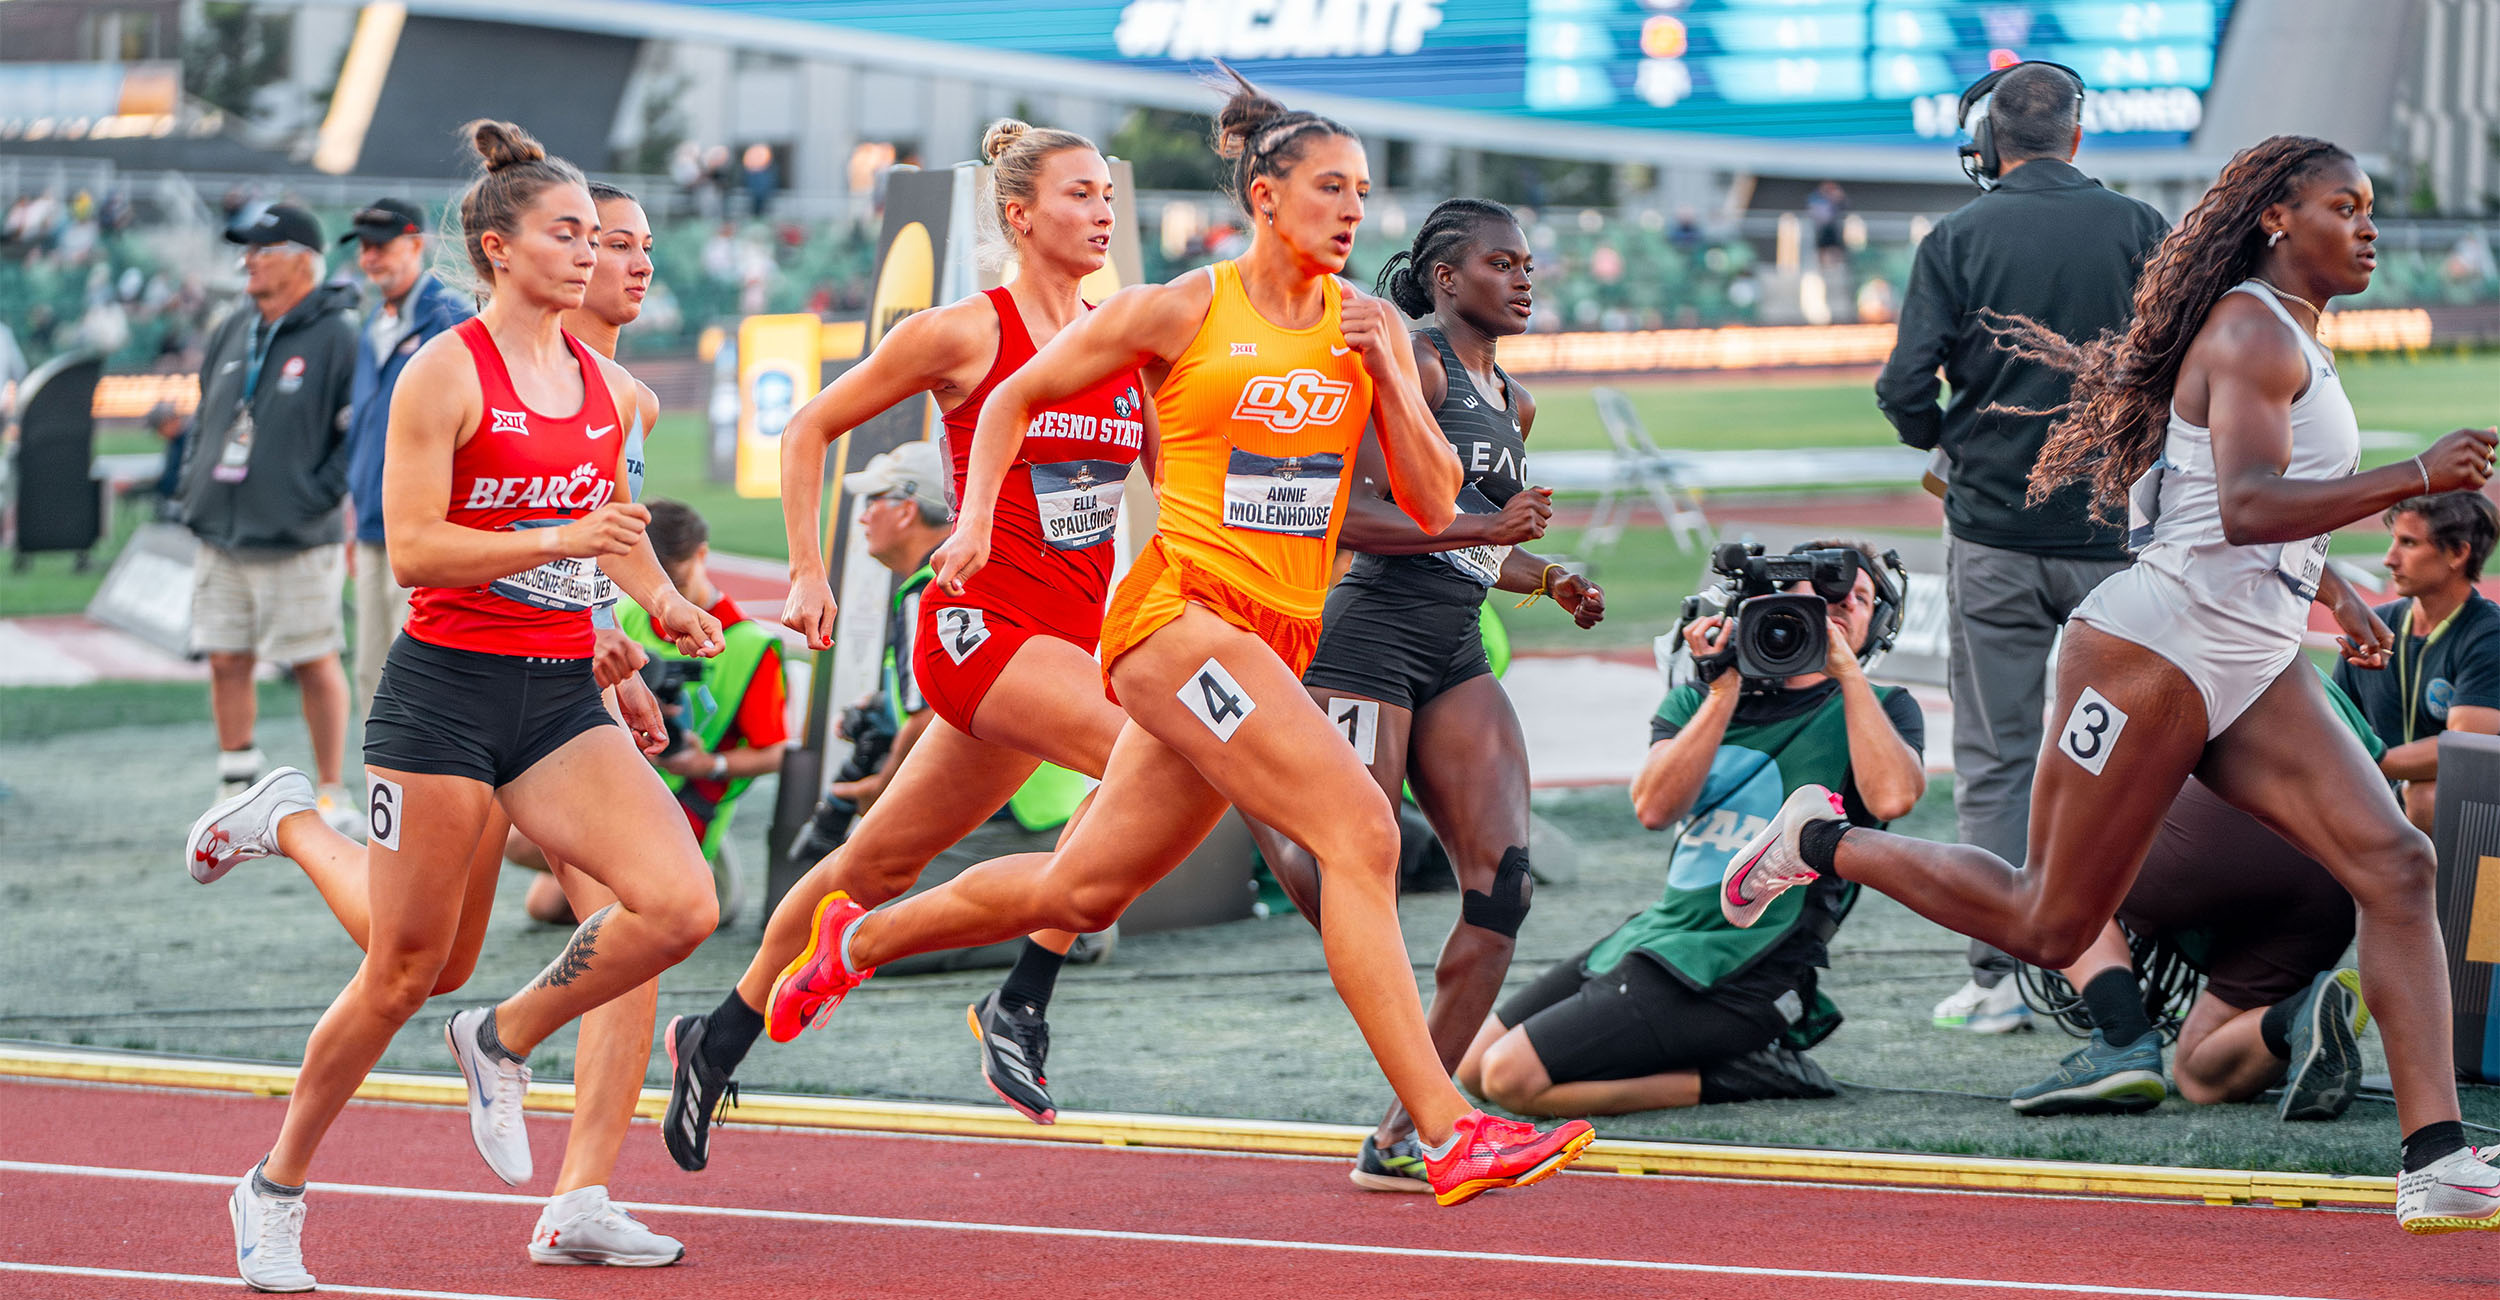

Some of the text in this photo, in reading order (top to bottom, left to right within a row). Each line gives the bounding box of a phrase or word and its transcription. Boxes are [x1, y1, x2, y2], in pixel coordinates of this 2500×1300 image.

[1233, 369, 1353, 432] OSU
[1074, 495, 1098, 511] ELLA
[1229, 501, 1331, 527] MOLENHOUSE
[1266, 486, 1308, 503] ANNIE
[1050, 507, 1115, 538] SPAULDING
[946, 609, 982, 657] 2
[1198, 670, 1244, 725] 4
[1338, 704, 1359, 748] 1
[2070, 702, 2110, 759] 3
[371, 783, 393, 840] 6
